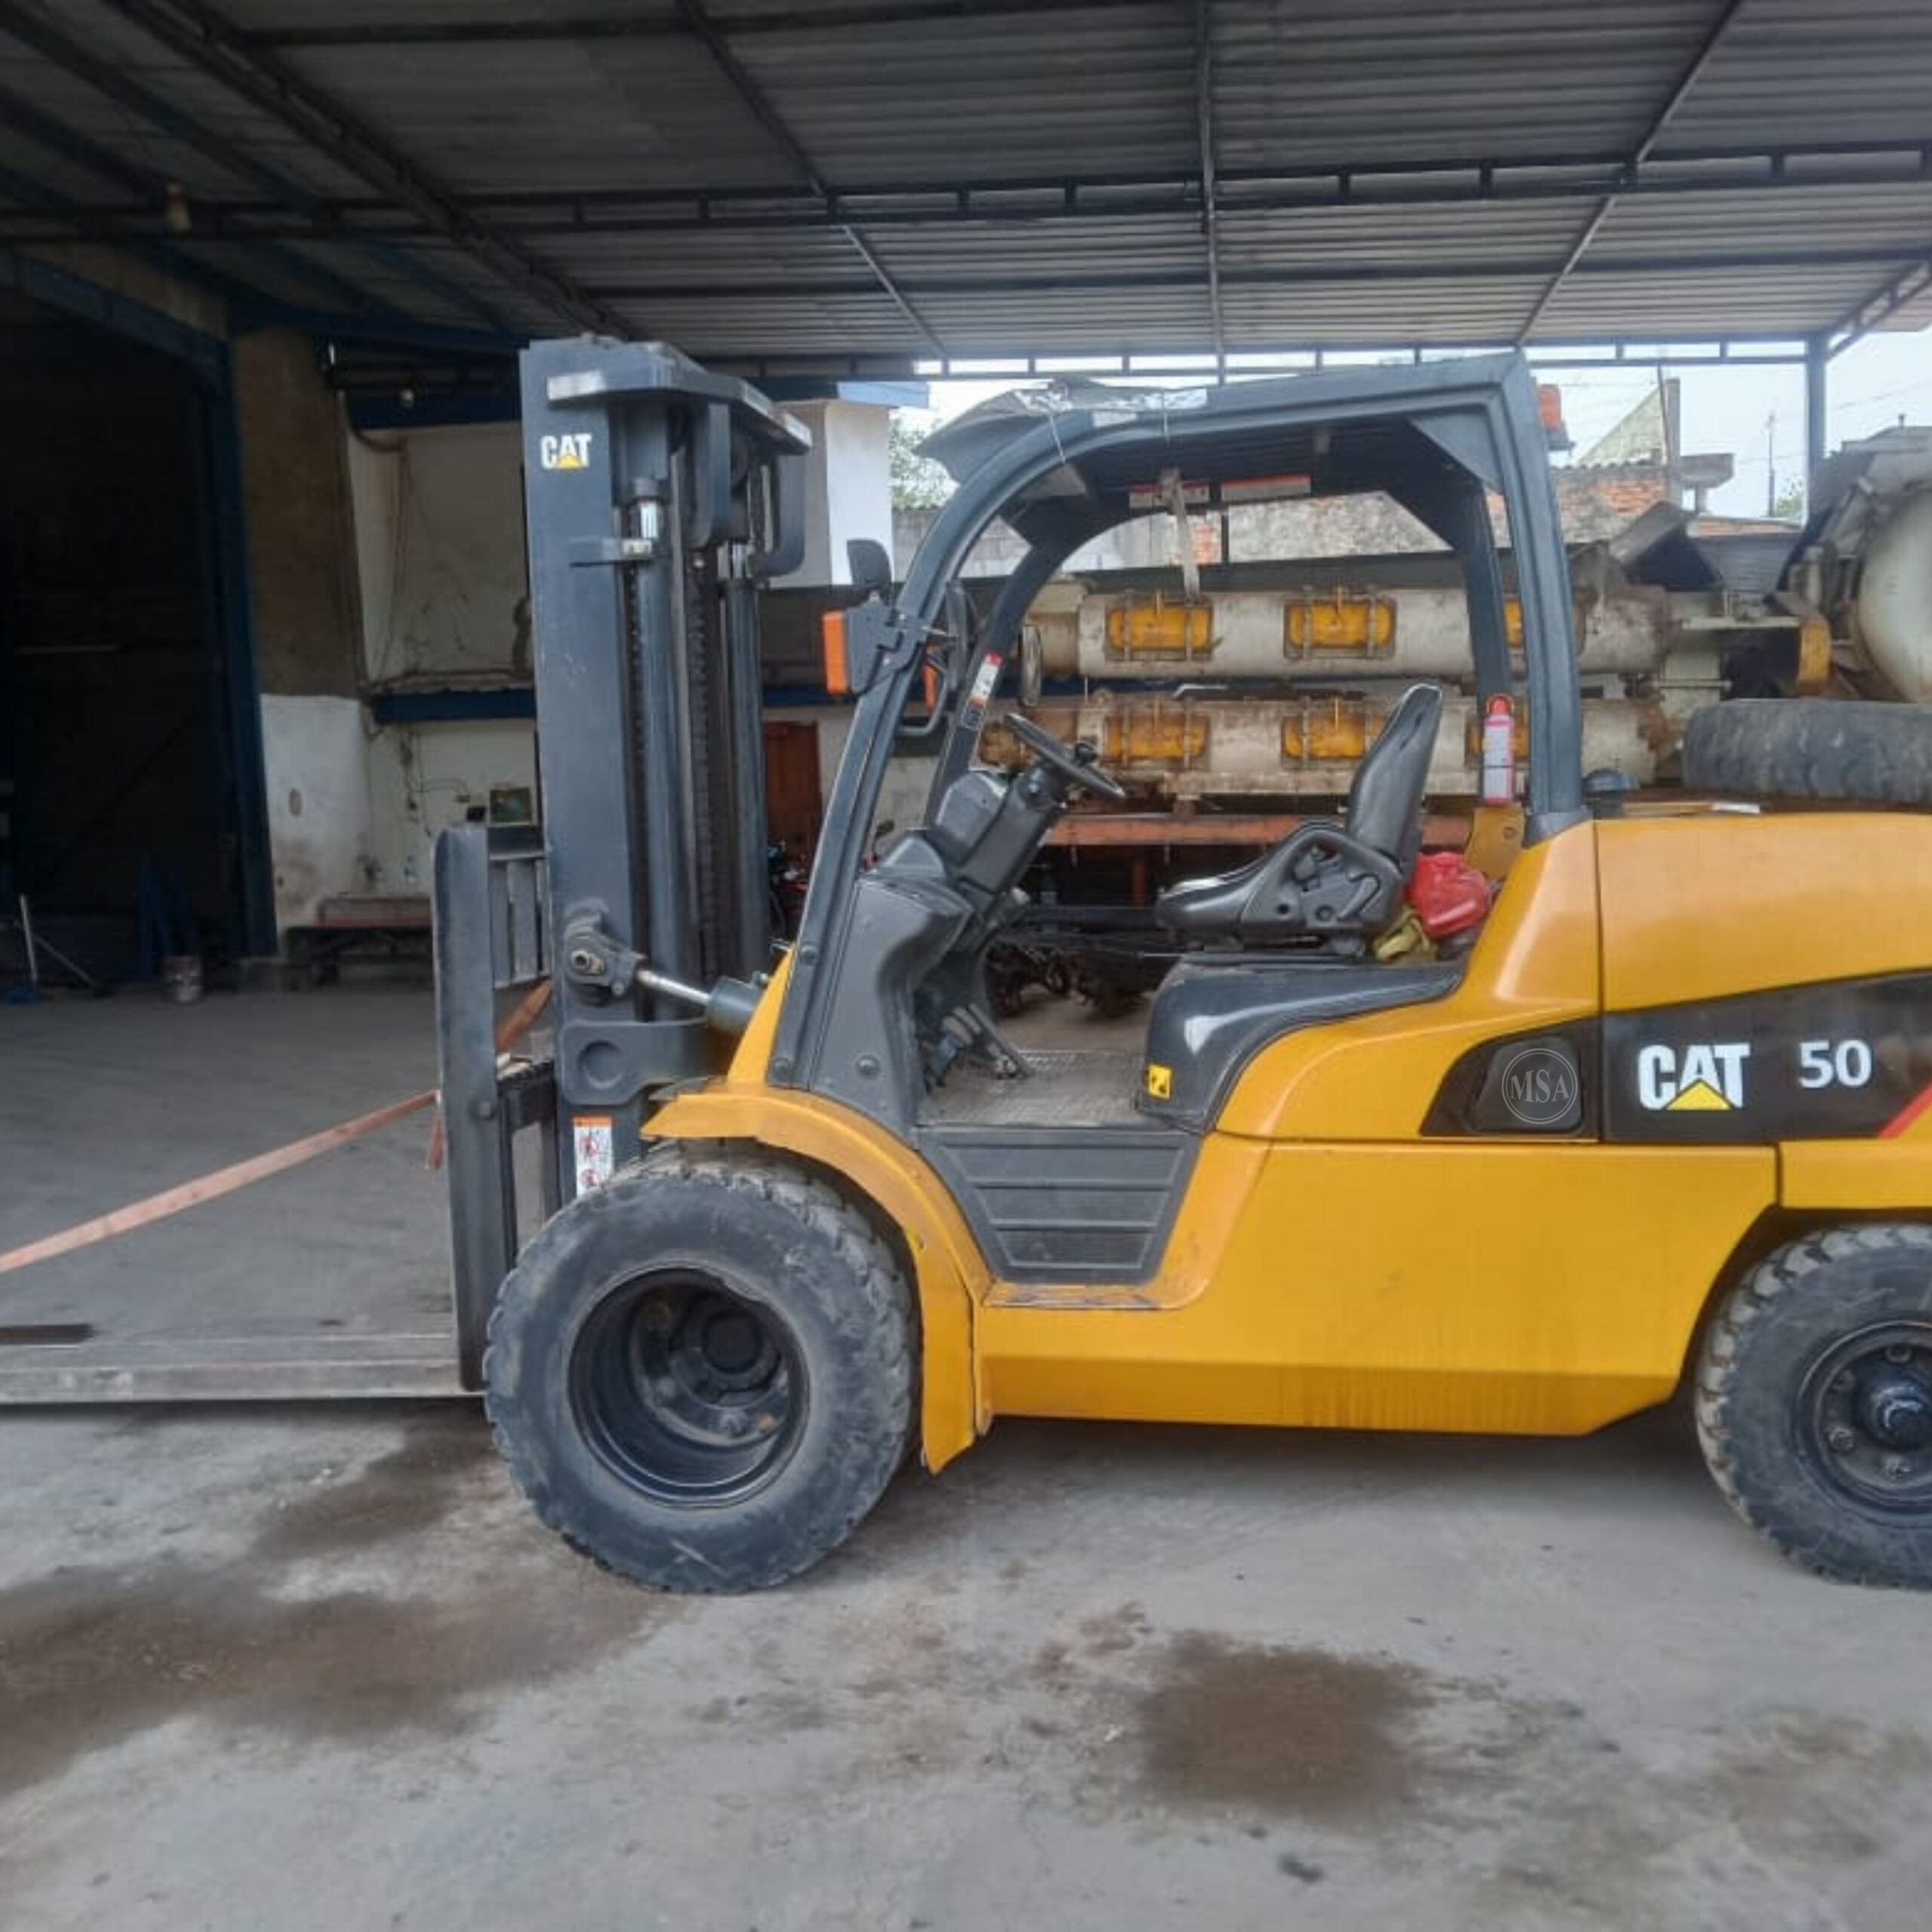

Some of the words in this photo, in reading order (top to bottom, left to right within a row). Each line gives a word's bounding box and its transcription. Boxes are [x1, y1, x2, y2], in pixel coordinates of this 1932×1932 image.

[541, 432, 592, 469] CAT
[1637, 1041, 1751, 1110] CAT
[1799, 1038, 1872, 1089] 50
